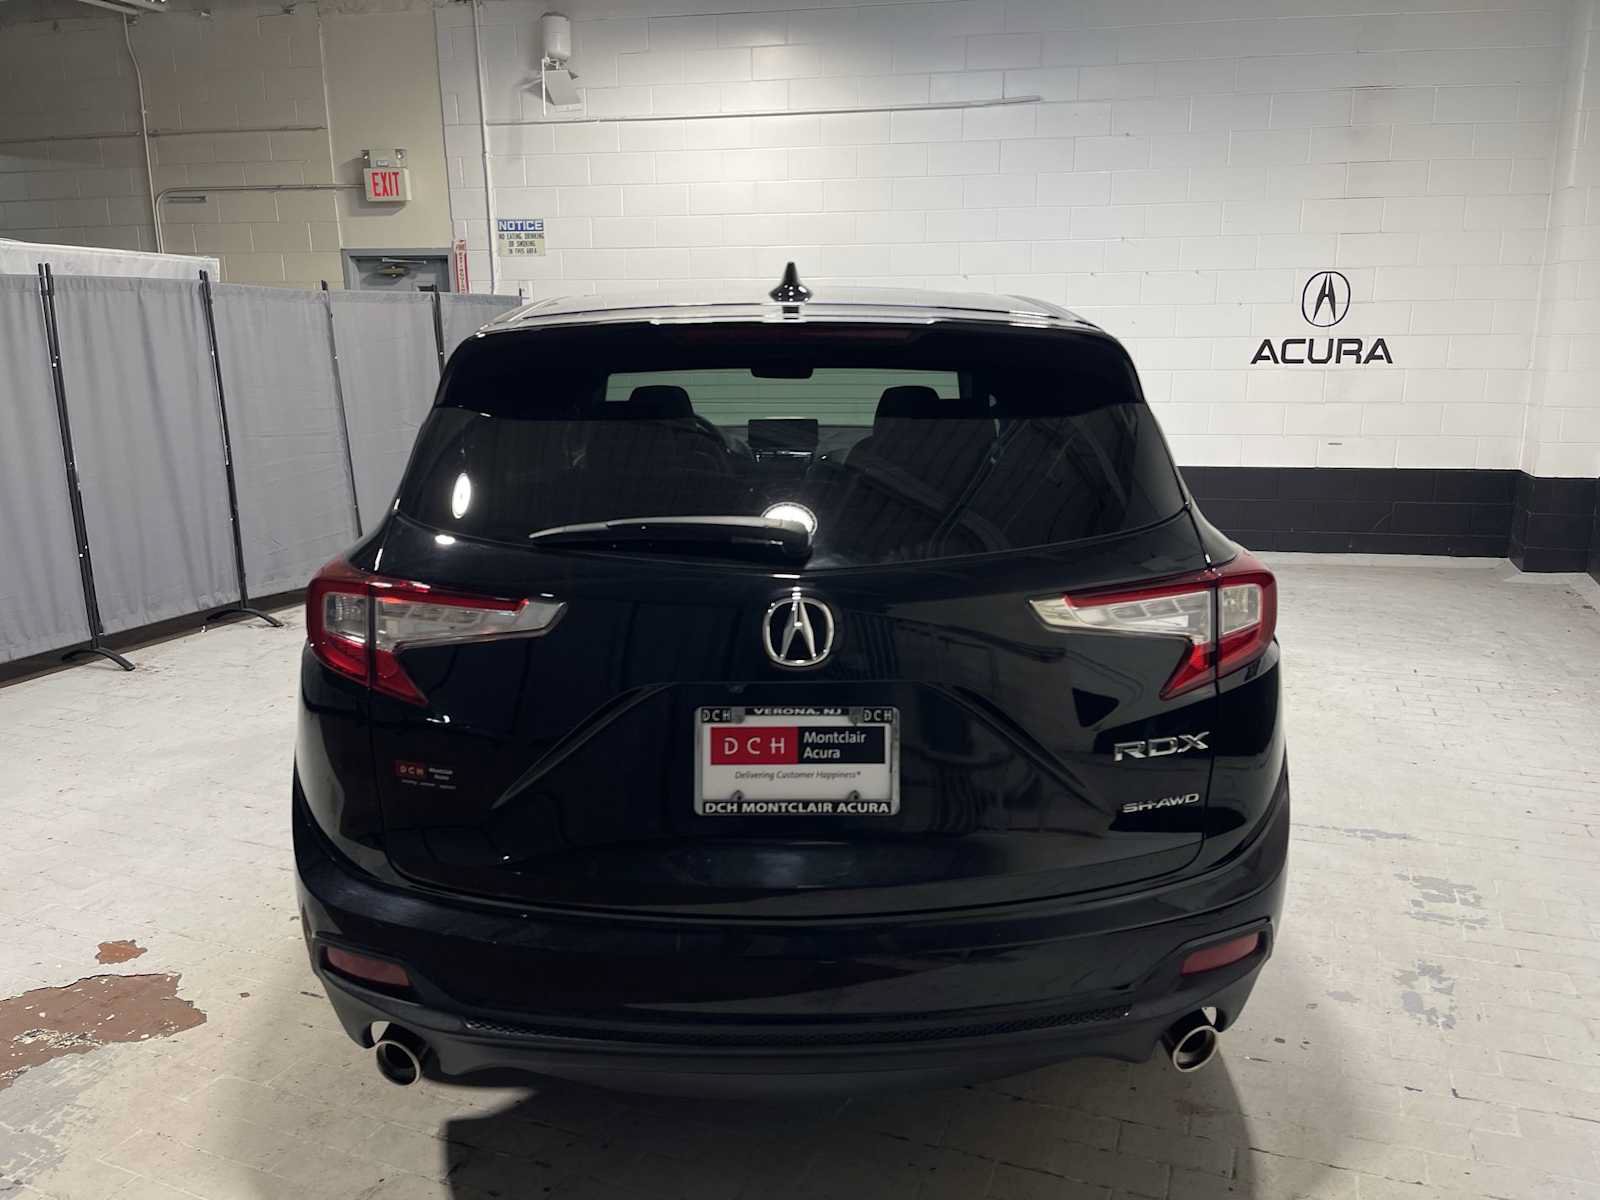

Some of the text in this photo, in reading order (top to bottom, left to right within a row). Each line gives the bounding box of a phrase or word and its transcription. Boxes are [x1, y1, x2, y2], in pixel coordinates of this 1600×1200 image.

[371, 171, 400, 197] EXIT
[498, 220, 544, 231] NOTICE
[1250, 338, 1393, 364] ACURA
[703, 710, 731, 721] DCH
[822, 708, 842, 716] NJ
[864, 710, 892, 721] DCH
[803, 731, 866, 744] Montclair
[724, 737, 785, 755] DCH
[1113, 731, 1210, 761] RDX
[803, 747, 841, 759] Acura
[734, 770, 775, 781] Delivering
[776, 770, 814, 780] Customer
[705, 802, 890, 814] DCH MONTCLAIR ACURA
[1122, 793, 1200, 813] SH-AWD
